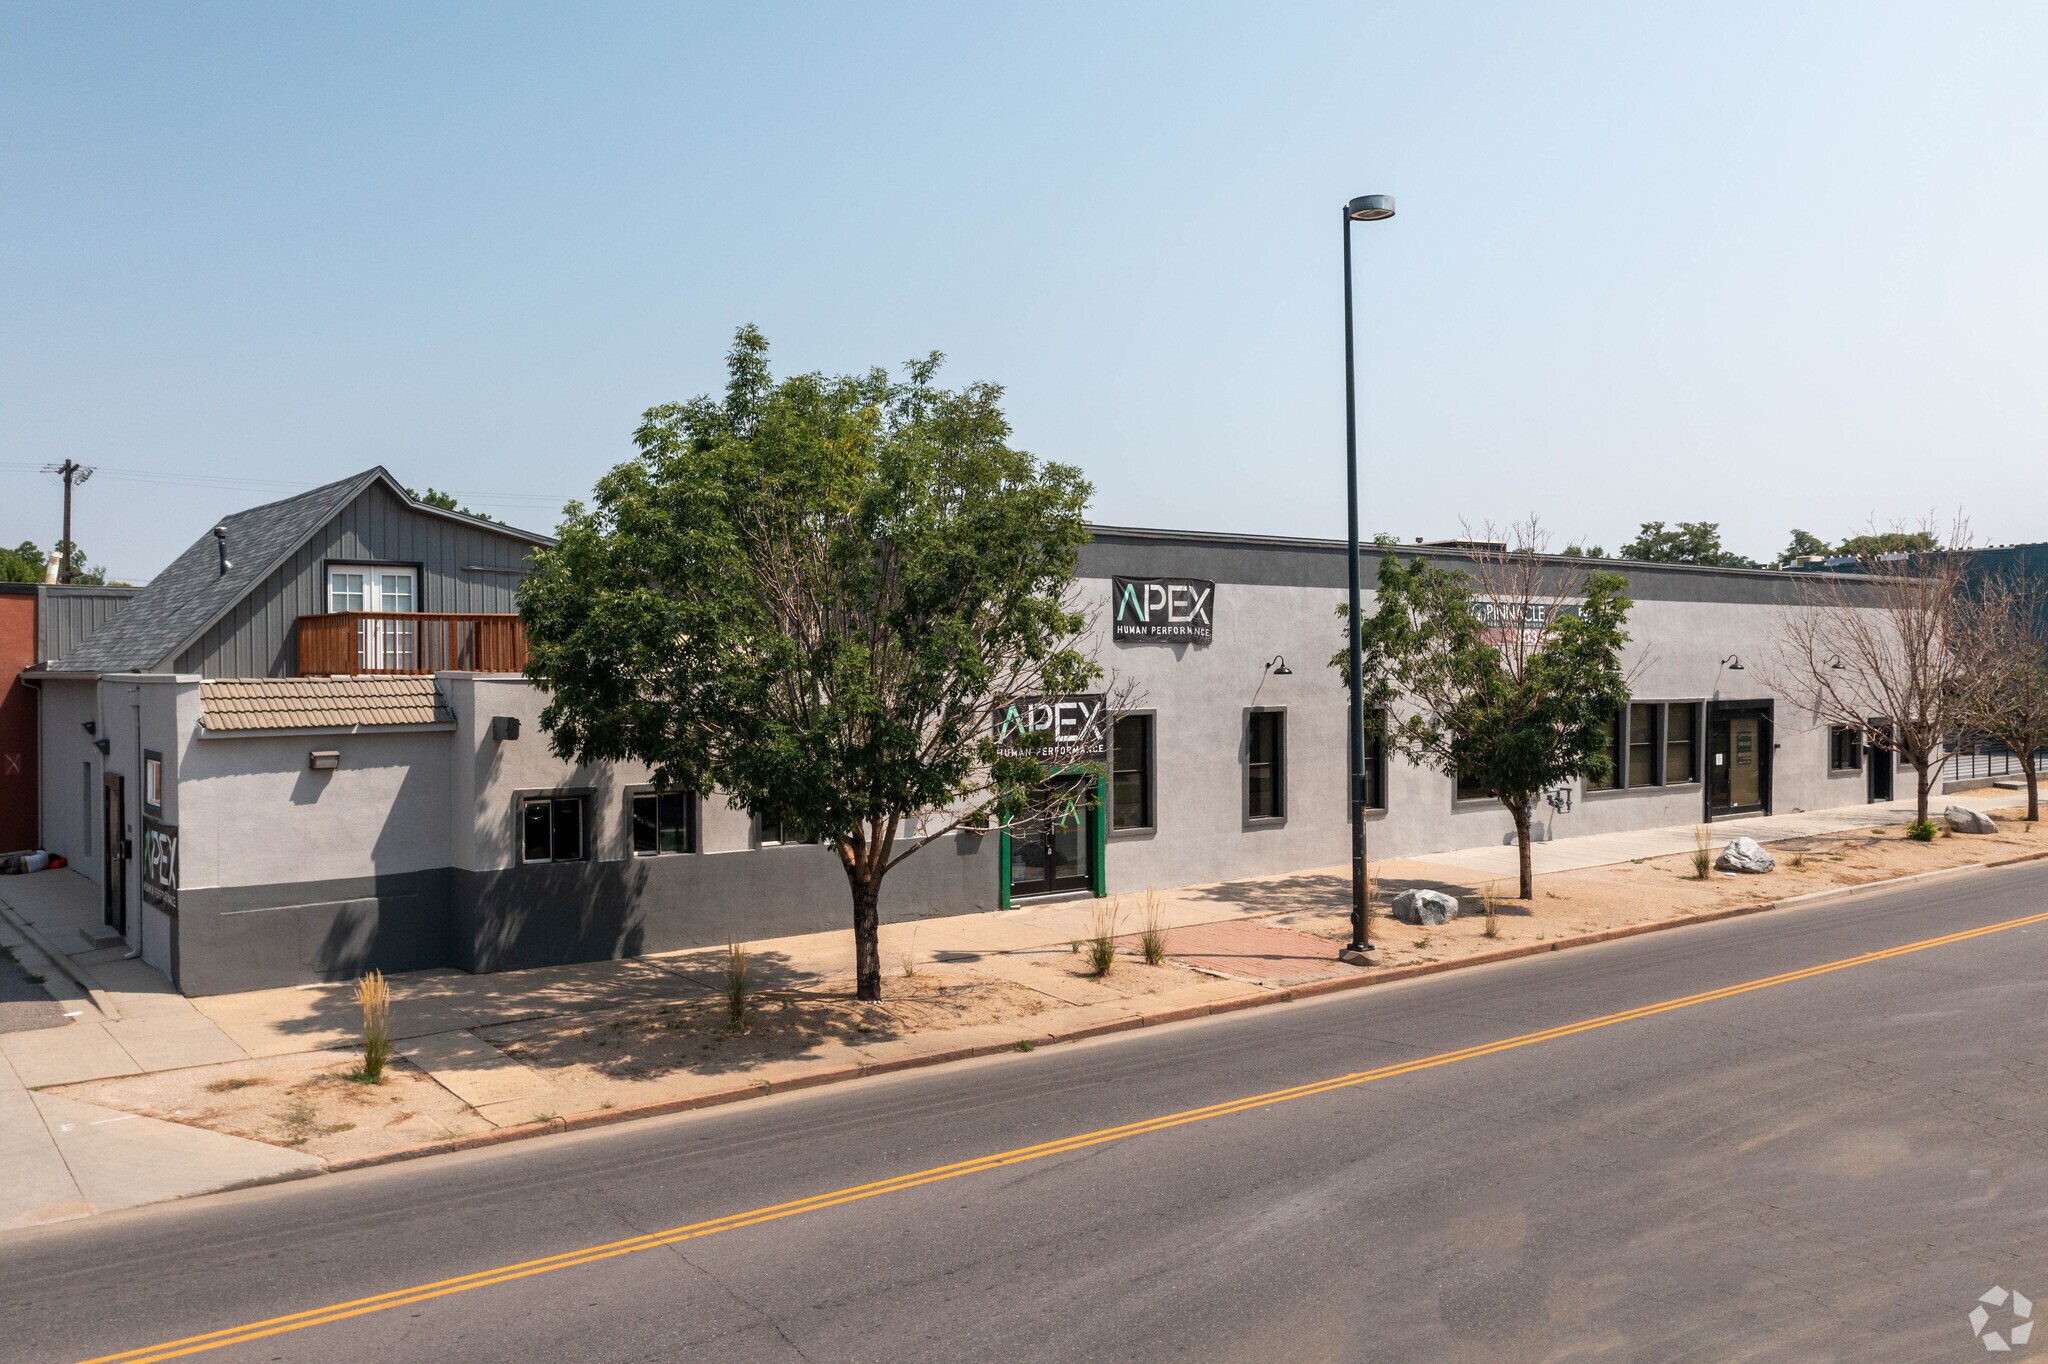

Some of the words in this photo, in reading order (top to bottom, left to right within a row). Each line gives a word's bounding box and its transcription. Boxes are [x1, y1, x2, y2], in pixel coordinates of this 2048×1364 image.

[1117, 584, 1211, 625] APEX
[1117, 626, 1147, 634] HUMAN
[1151, 626, 1210, 637] PERFORMNCE
[998, 702, 1103, 744] APEX
[1036, 745, 1104, 756] ERFORMCE
[144, 829, 177, 890] APEX
